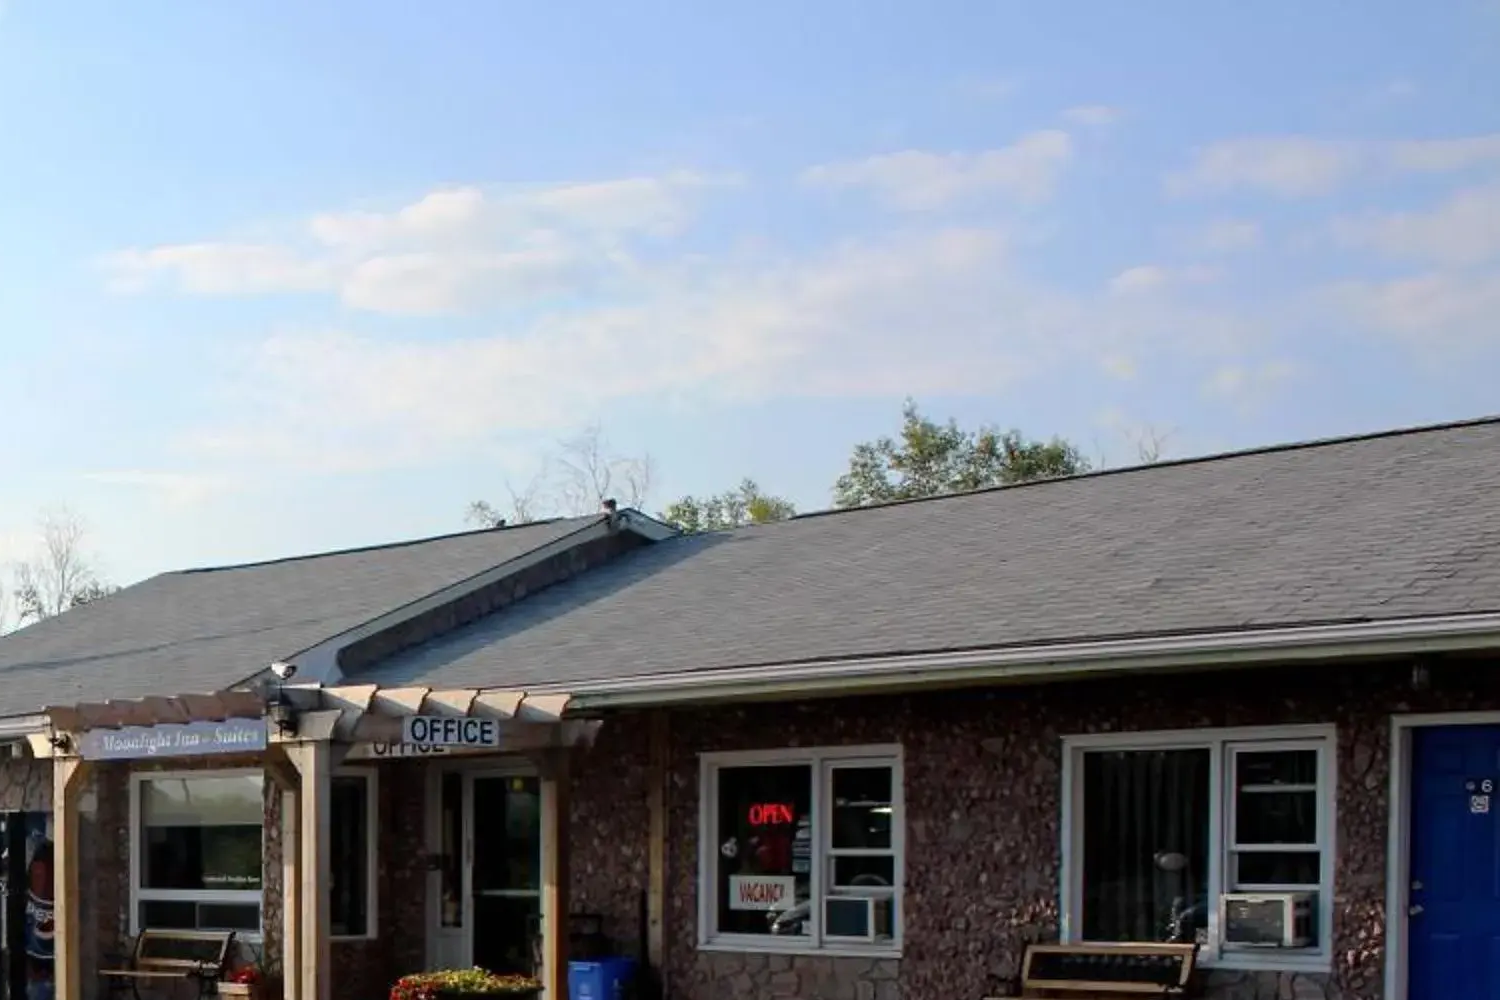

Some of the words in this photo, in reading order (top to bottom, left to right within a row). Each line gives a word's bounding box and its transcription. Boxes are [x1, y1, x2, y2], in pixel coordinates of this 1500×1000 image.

[102, 731, 171, 754] Moonlight
[174, 729, 199, 747] Inn
[212, 725, 259, 745] Suites
[411, 717, 493, 744] OFFICE
[1481, 779, 1493, 793] 6
[749, 804, 792, 824] OPEN
[740, 882, 784, 903] VACANCY
